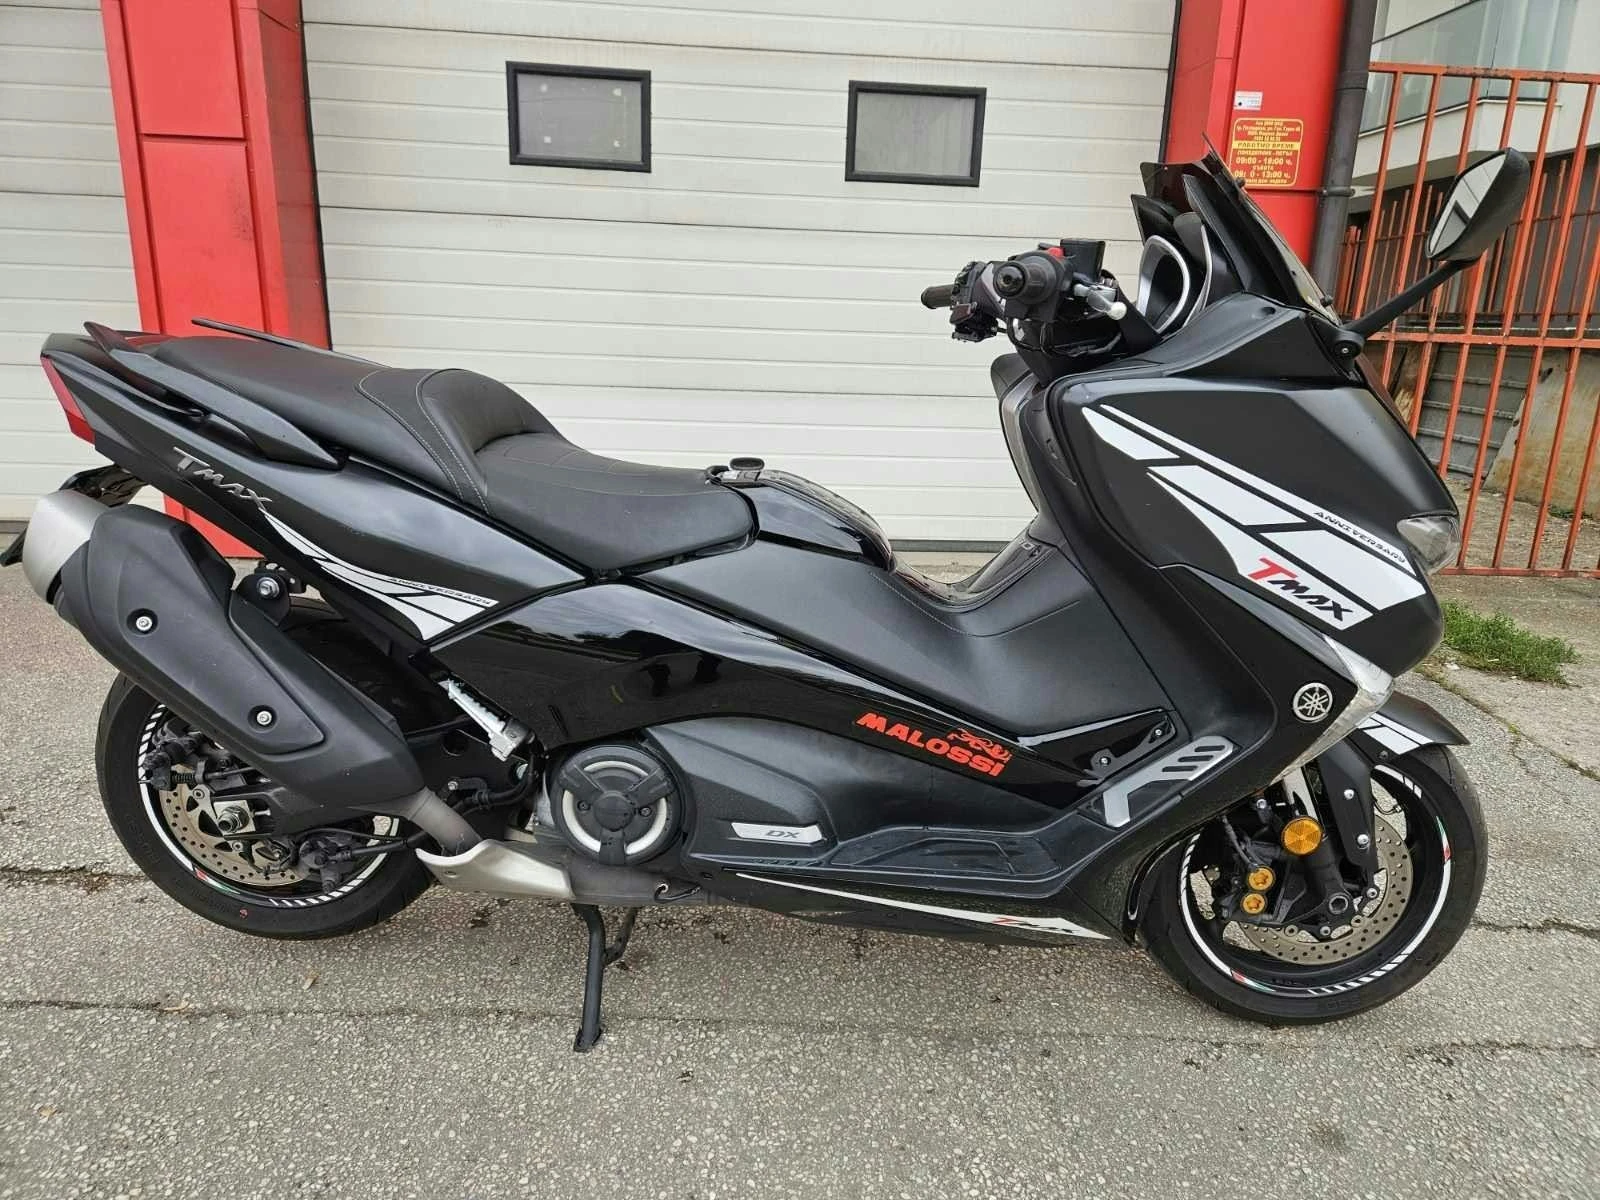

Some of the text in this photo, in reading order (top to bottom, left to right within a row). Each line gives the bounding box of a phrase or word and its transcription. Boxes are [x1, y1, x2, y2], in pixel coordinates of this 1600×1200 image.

[1235, 157, 1257, 165] 09:00
[173, 446, 273, 513] TMAX
[1313, 510, 1406, 563] ANNIVERSARY
[388, 577, 492, 605] ANNIVERSARY
[1248, 557, 1354, 621] TMAX
[856, 712, 1005, 777] MALOSSI
[766, 830, 799, 838] DX
